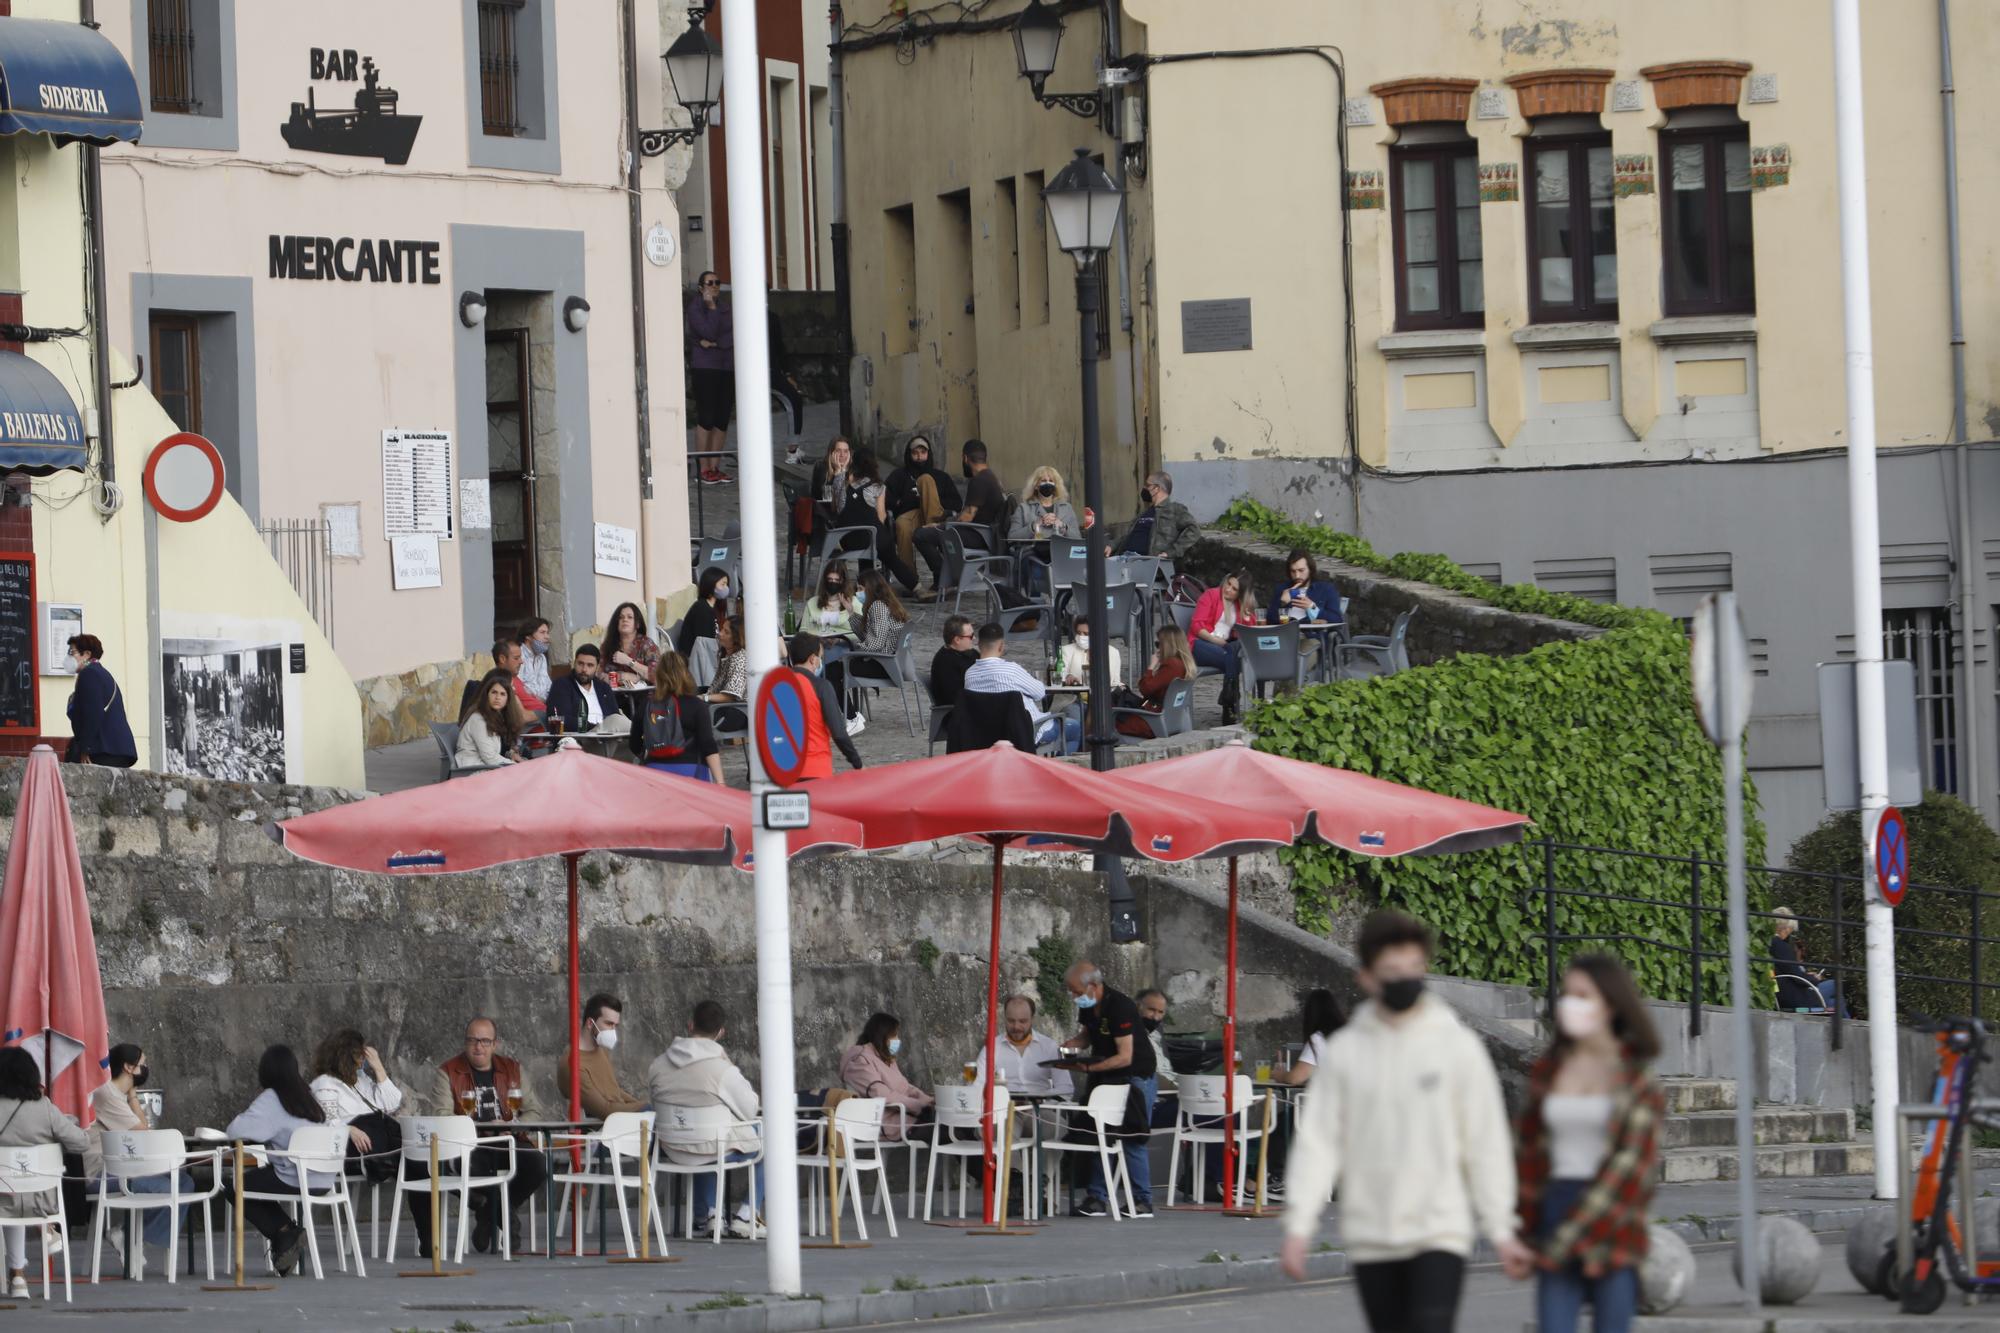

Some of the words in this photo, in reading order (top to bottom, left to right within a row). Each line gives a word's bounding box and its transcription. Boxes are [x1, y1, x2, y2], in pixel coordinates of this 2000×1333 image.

[310, 47, 359, 82] BAR
[39, 83, 109, 114] SIDRERIA
[269, 234, 441, 284] MERCANTE
[3, 412, 67, 441] BALLENAS
[14, 661, 32, 689] 15
